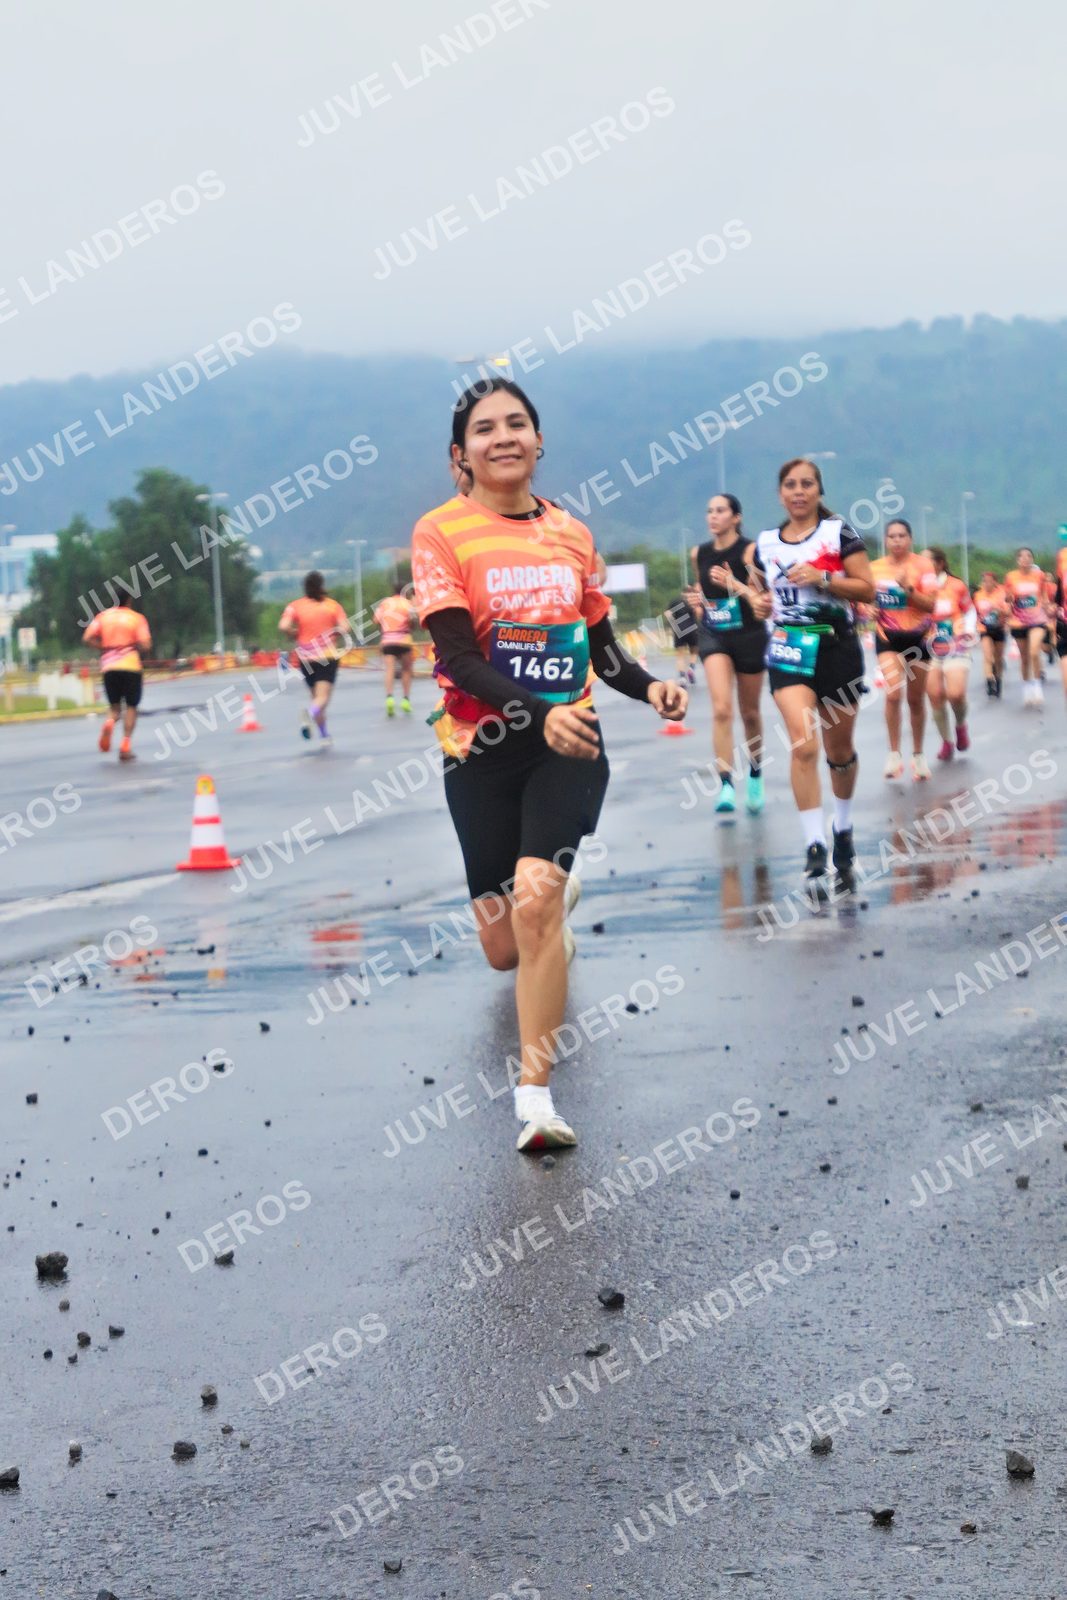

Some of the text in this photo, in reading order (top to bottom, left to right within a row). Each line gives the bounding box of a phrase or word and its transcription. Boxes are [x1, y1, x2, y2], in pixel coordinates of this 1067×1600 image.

[486, 565, 576, 593] CARRERA
[497, 627, 548, 643] CARRERA
[771, 644, 802, 662] 1506
[509, 656, 574, 680] 1462
